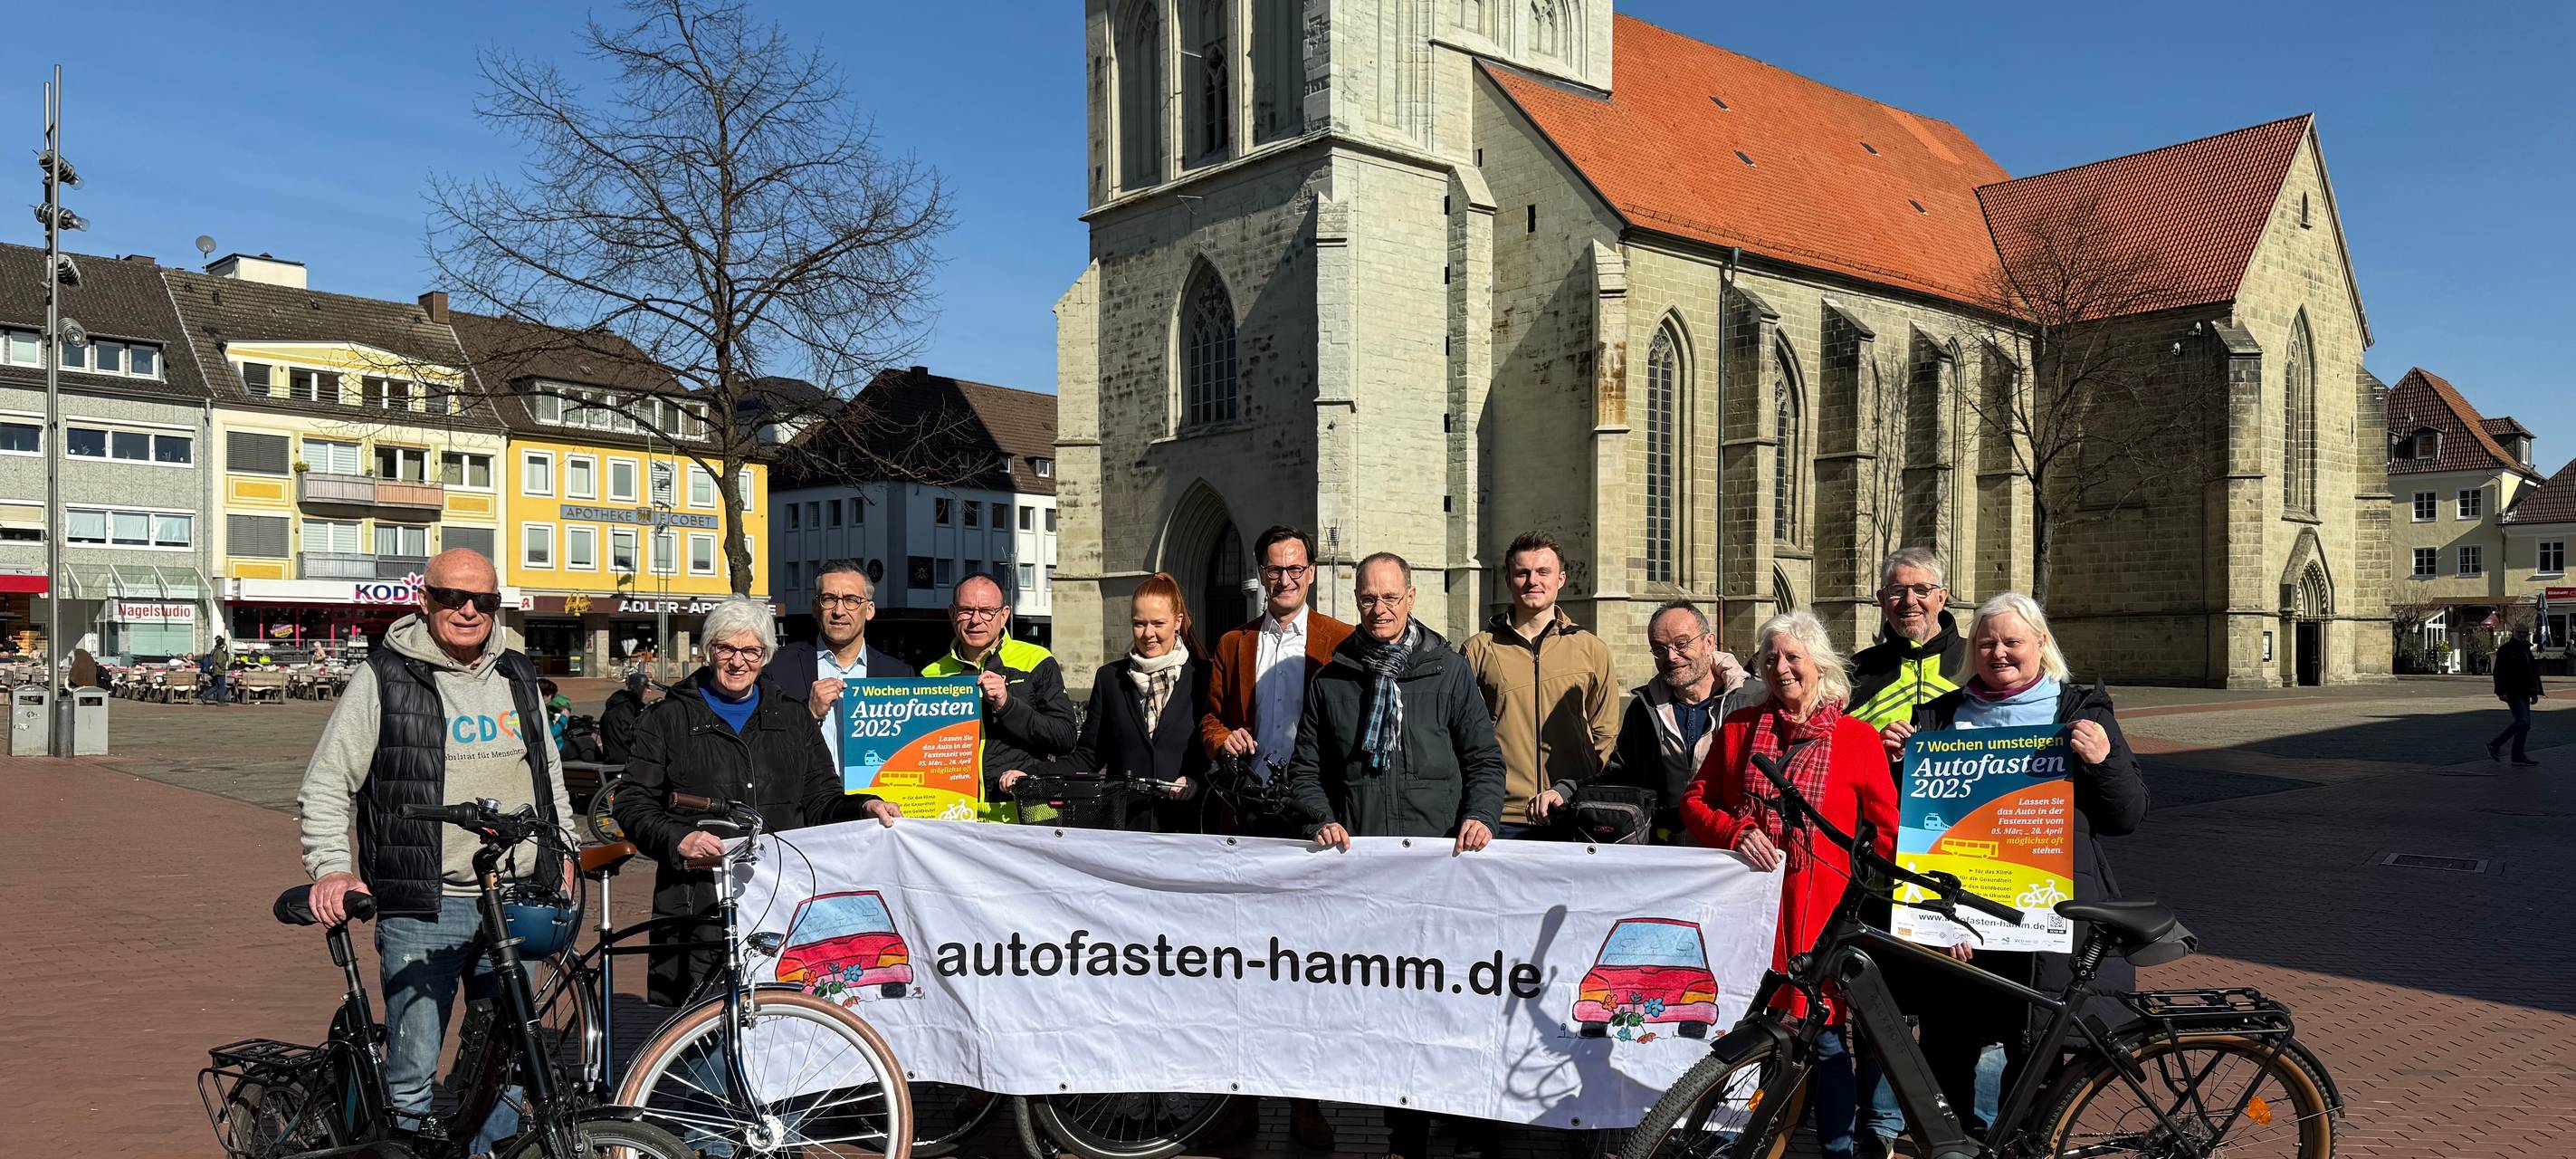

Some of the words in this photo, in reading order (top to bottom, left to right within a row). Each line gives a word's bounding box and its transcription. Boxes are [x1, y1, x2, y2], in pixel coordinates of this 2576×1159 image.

[566, 507, 632, 522] APOTHEKE
[671, 515, 711, 527] COBET
[118, 603, 191, 619] Nagelstudio
[852, 686, 860, 696] 7
[863, 685, 910, 696] Wochen
[913, 684, 974, 698] umsteigen
[851, 699, 975, 722] Autofasten
[851, 719, 902, 738] 2025
[1915, 741, 1924, 753] 7
[1927, 739, 1983, 752] Wochen
[1988, 734, 2064, 751] umsteigen
[444, 752, 476, 761] obilität
[477, 752, 490, 760] für
[491, 748, 526, 759] Menschen
[1911, 753, 2066, 781] Autofasten
[1910, 778, 1973, 799] 2025
[2018, 798, 2049, 806] Lassen
[2037, 807, 2047, 815] in
[2048, 807, 2065, 815] der
[1999, 817, 2044, 825] Fastenzeit
[2044, 828, 2063, 836] April
[2006, 837, 2048, 846] möglichst
[2050, 836, 2064, 846] oft
[1918, 913, 2046, 932] www.ofasten-ham.de
[936, 929, 1542, 1000] autofasten-hamm.de
